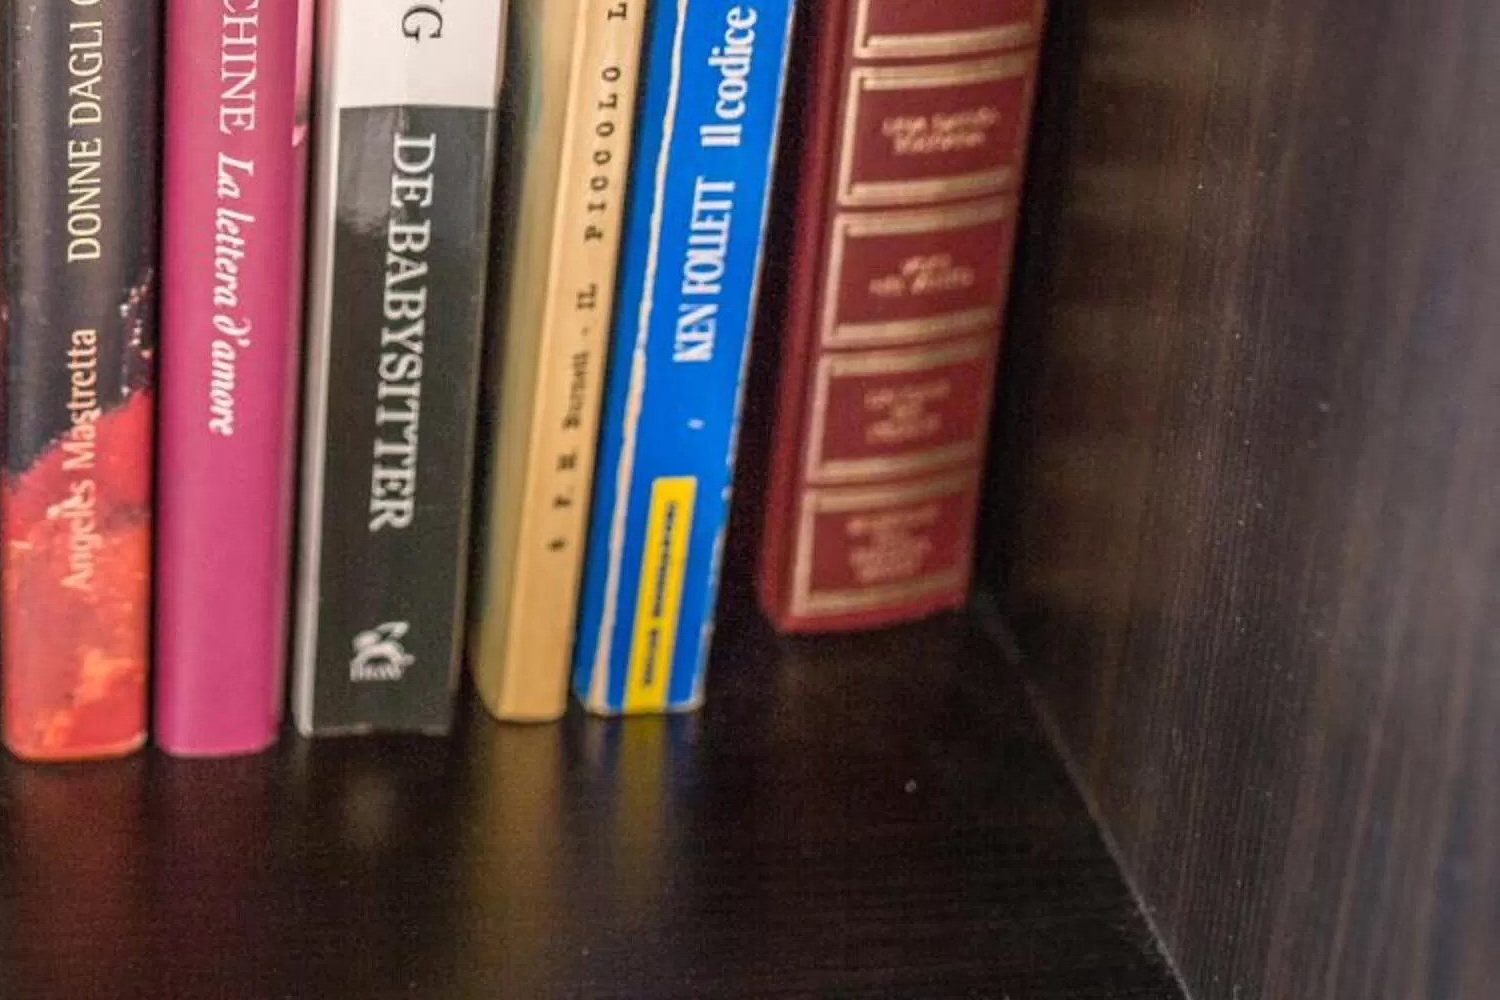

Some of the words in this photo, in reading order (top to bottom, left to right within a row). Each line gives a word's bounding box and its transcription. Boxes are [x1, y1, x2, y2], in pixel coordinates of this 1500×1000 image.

[68, 20, 103, 127] DAGLI
[708, 6, 758, 120] codice
[217, 152, 254, 199] La
[390, 133, 436, 208] DE
[584, 66, 621, 243] PICCOLO
[701, 123, 743, 148] Il
[68, 138, 101, 263] DONNE
[214, 207, 255, 307] lettera
[681, 176, 736, 295] FOLLETT
[209, 312, 252, 437] d'amore
[369, 218, 431, 532] BABYSITTER
[672, 303, 719, 364] KEN
[62, 328, 100, 471] Mastretta
